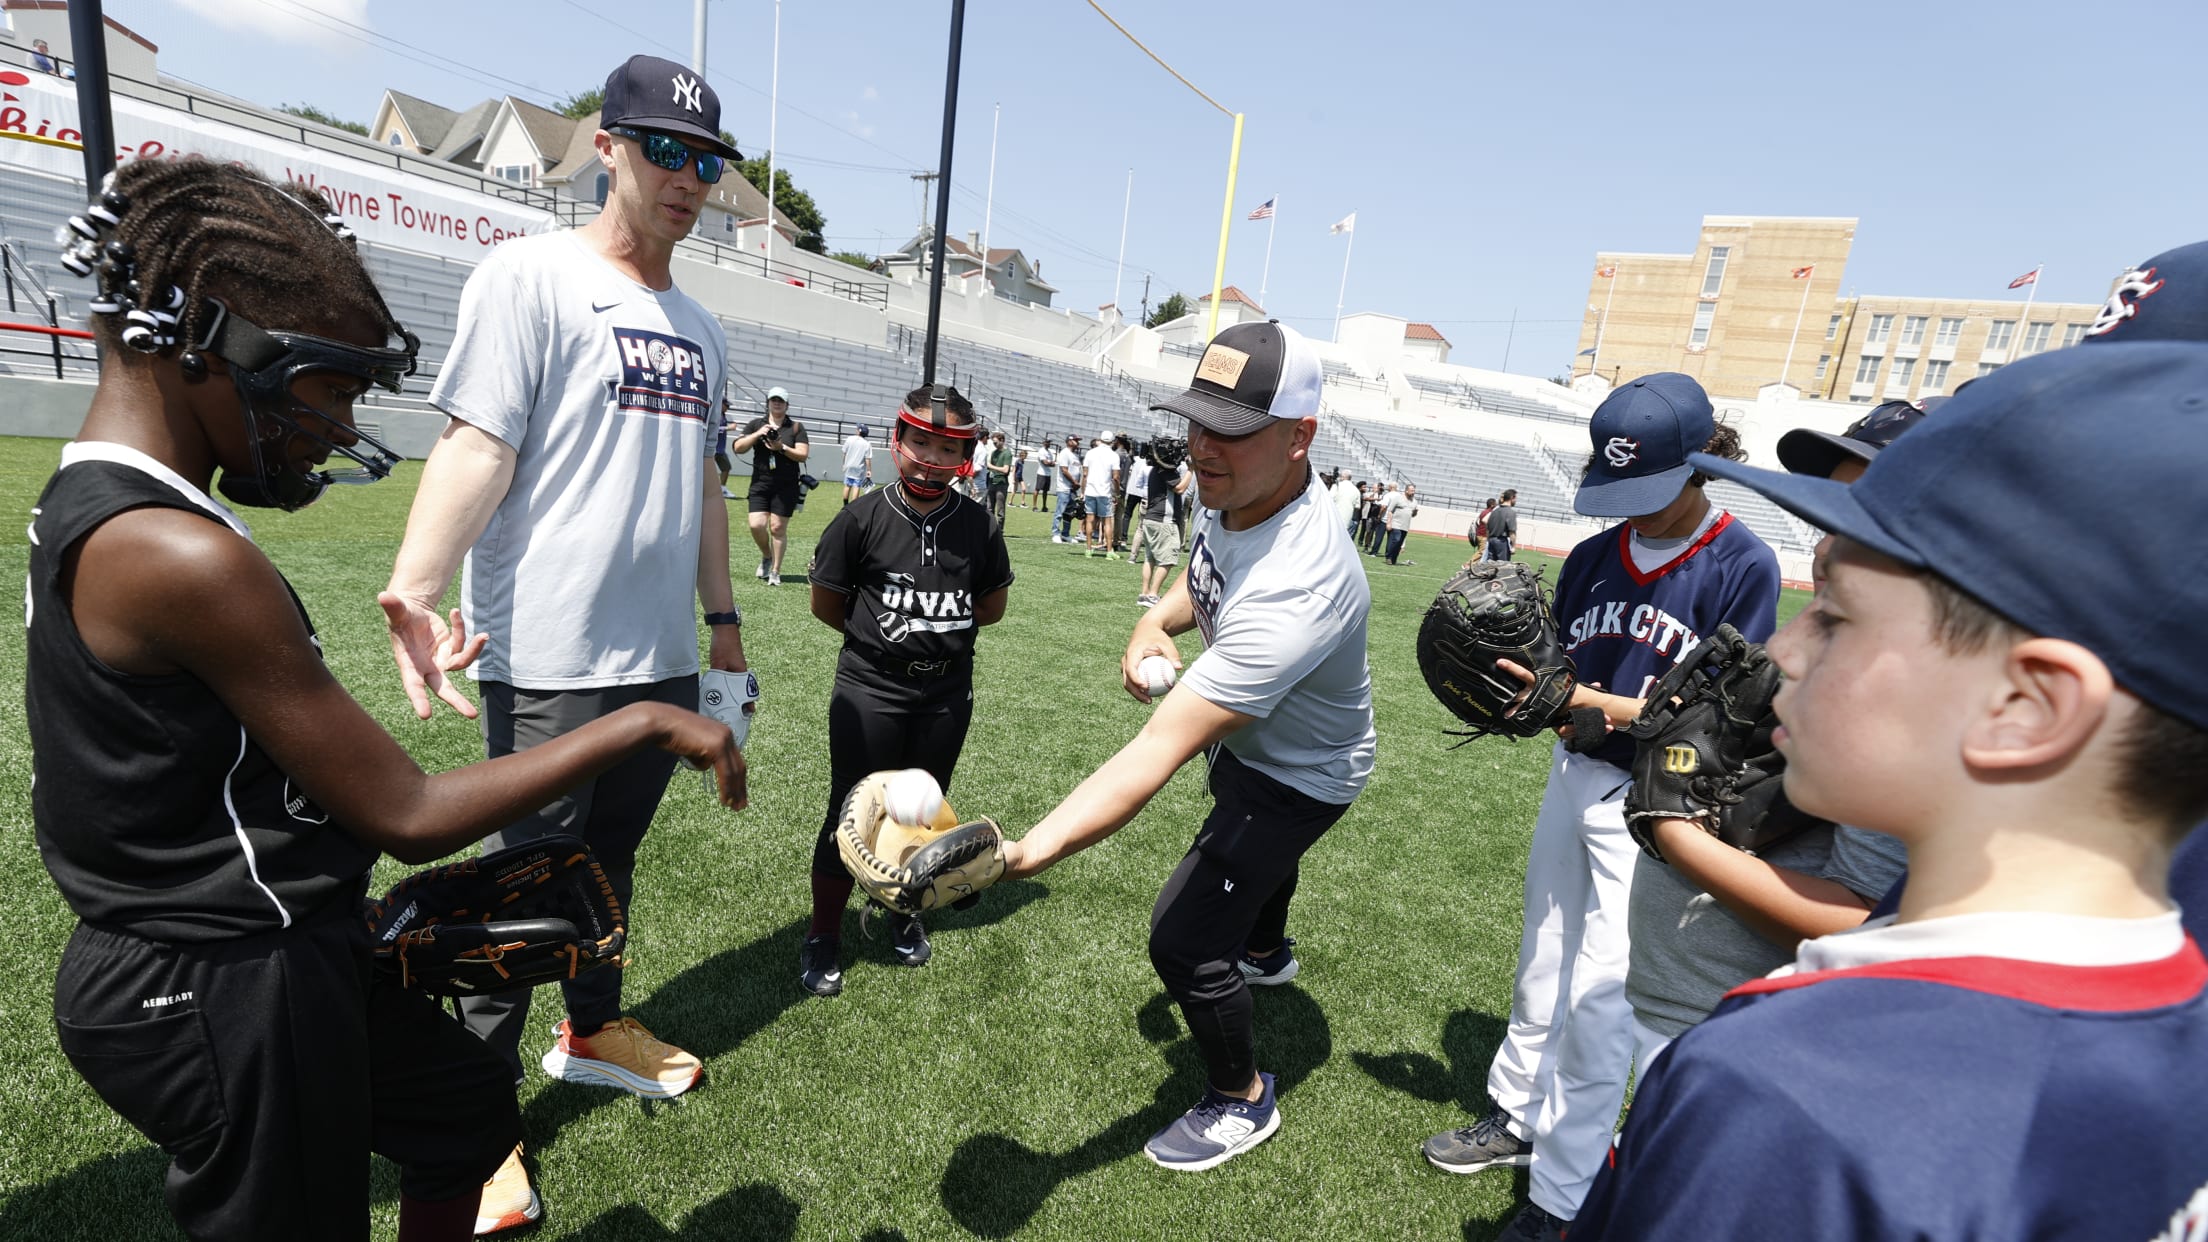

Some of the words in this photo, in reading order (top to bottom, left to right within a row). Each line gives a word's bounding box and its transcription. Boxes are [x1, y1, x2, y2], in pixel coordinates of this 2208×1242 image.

[387, 194, 468, 241] Towne
[619, 335, 705, 382] HOPE
[641, 371, 699, 391] WEEK
[1629, 603, 1701, 667] CITY
